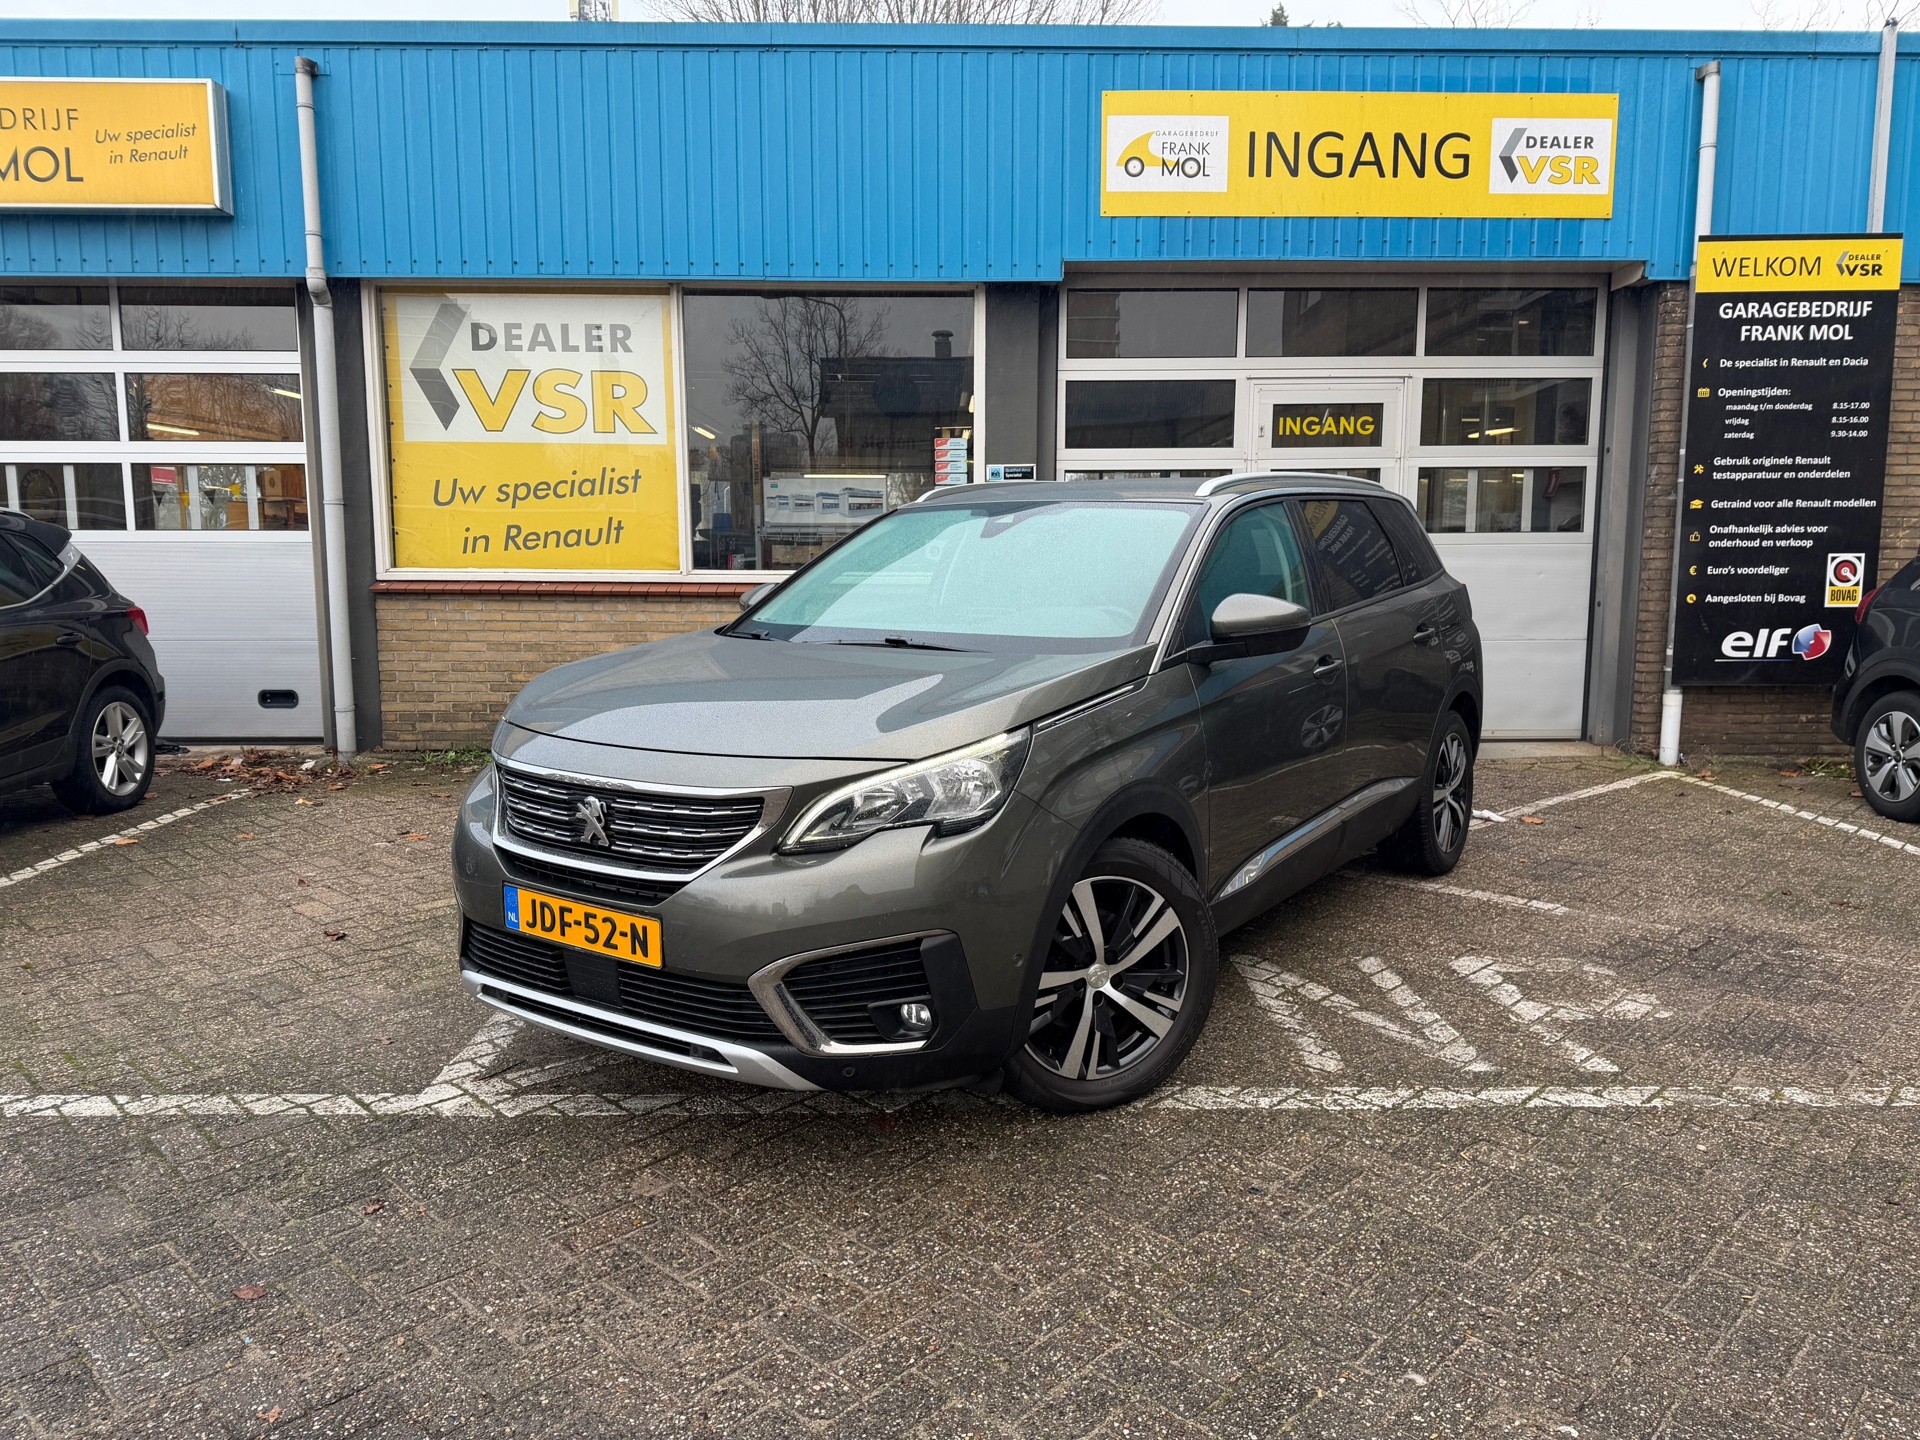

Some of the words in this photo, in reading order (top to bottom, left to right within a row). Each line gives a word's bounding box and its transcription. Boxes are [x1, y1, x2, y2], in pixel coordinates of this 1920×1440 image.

[0, 107, 79, 131] DRIJF
[95, 129, 121, 144] Uw
[126, 122, 197, 144] specialist
[1161, 141, 1211, 156] FRANK
[1525, 135, 1595, 149] DEALER
[109, 150, 123, 164] in
[129, 144, 188, 163] Renault
[1248, 130, 1471, 180] INGANG
[1161, 156, 1211, 179] MOL
[1516, 155, 1601, 185] VSR
[1848, 253, 1881, 261] DEALER
[1712, 256, 1822, 278] WELKOM
[1845, 263, 1884, 277] VSR
[1718, 300, 1873, 319] GARAGEBEDRIJF
[469, 322, 633, 353] DEALER
[1740, 324, 1804, 342] FRANK
[1808, 323, 1854, 341] MOL
[1719, 358, 1733, 368] De
[1734, 358, 1778, 370] specialist
[1779, 358, 1789, 367] in
[1790, 357, 1827, 367] Renault
[1828, 359, 1841, 367] en
[1842, 357, 1869, 366] Dacia
[1717, 387, 1791, 399] Openingstijden:
[451, 368, 659, 435] VSR
[1725, 403, 1759, 412] maandag
[1759, 403, 1774, 411] t/m
[1774, 402, 1813, 411] donderdag
[1832, 401, 1870, 410] 8.15-17.00
[1278, 415, 1375, 436] INGANG
[1724, 417, 1750, 426] vrijdag
[1831, 415, 1869, 424] 8.15-16.00
[1723, 431, 1755, 440] zaterdag
[1830, 429, 1868, 438] 9.30-14.00
[1713, 456, 1751, 466] Gebruik
[1752, 457, 1794, 467] originele
[1794, 456, 1831, 465] Renault
[1712, 471, 1782, 481] testapparatuur
[1783, 471, 1796, 479] en
[1797, 470, 1851, 479] onderdelen
[432, 478, 486, 507] Uw
[495, 466, 642, 509] specialist
[1710, 499, 1752, 509] Getraind
[1753, 501, 1775, 509] voor
[1776, 499, 1794, 508] alle
[1795, 499, 1831, 508] Renault
[1833, 498, 1877, 508] modellen
[462, 527, 490, 554] in
[503, 516, 625, 552] Renault
[1709, 524, 1774, 535] Onafhankelijk
[1775, 524, 1805, 533] advies
[1806, 525, 1828, 533] voor
[1708, 539, 1760, 548] onderhoud
[1775, 538, 1813, 548] verkoop
[1736, 565, 1790, 576] voordeliger
[1705, 594, 1762, 604] Aangesloten
[1764, 593, 1776, 603] bij
[1777, 594, 1806, 604] Bovag
[1829, 589, 1857, 602] BOVAG
[1720, 628, 1792, 658] elf
[507, 911, 518, 923] NL
[525, 898, 649, 958] JDF-52-N
